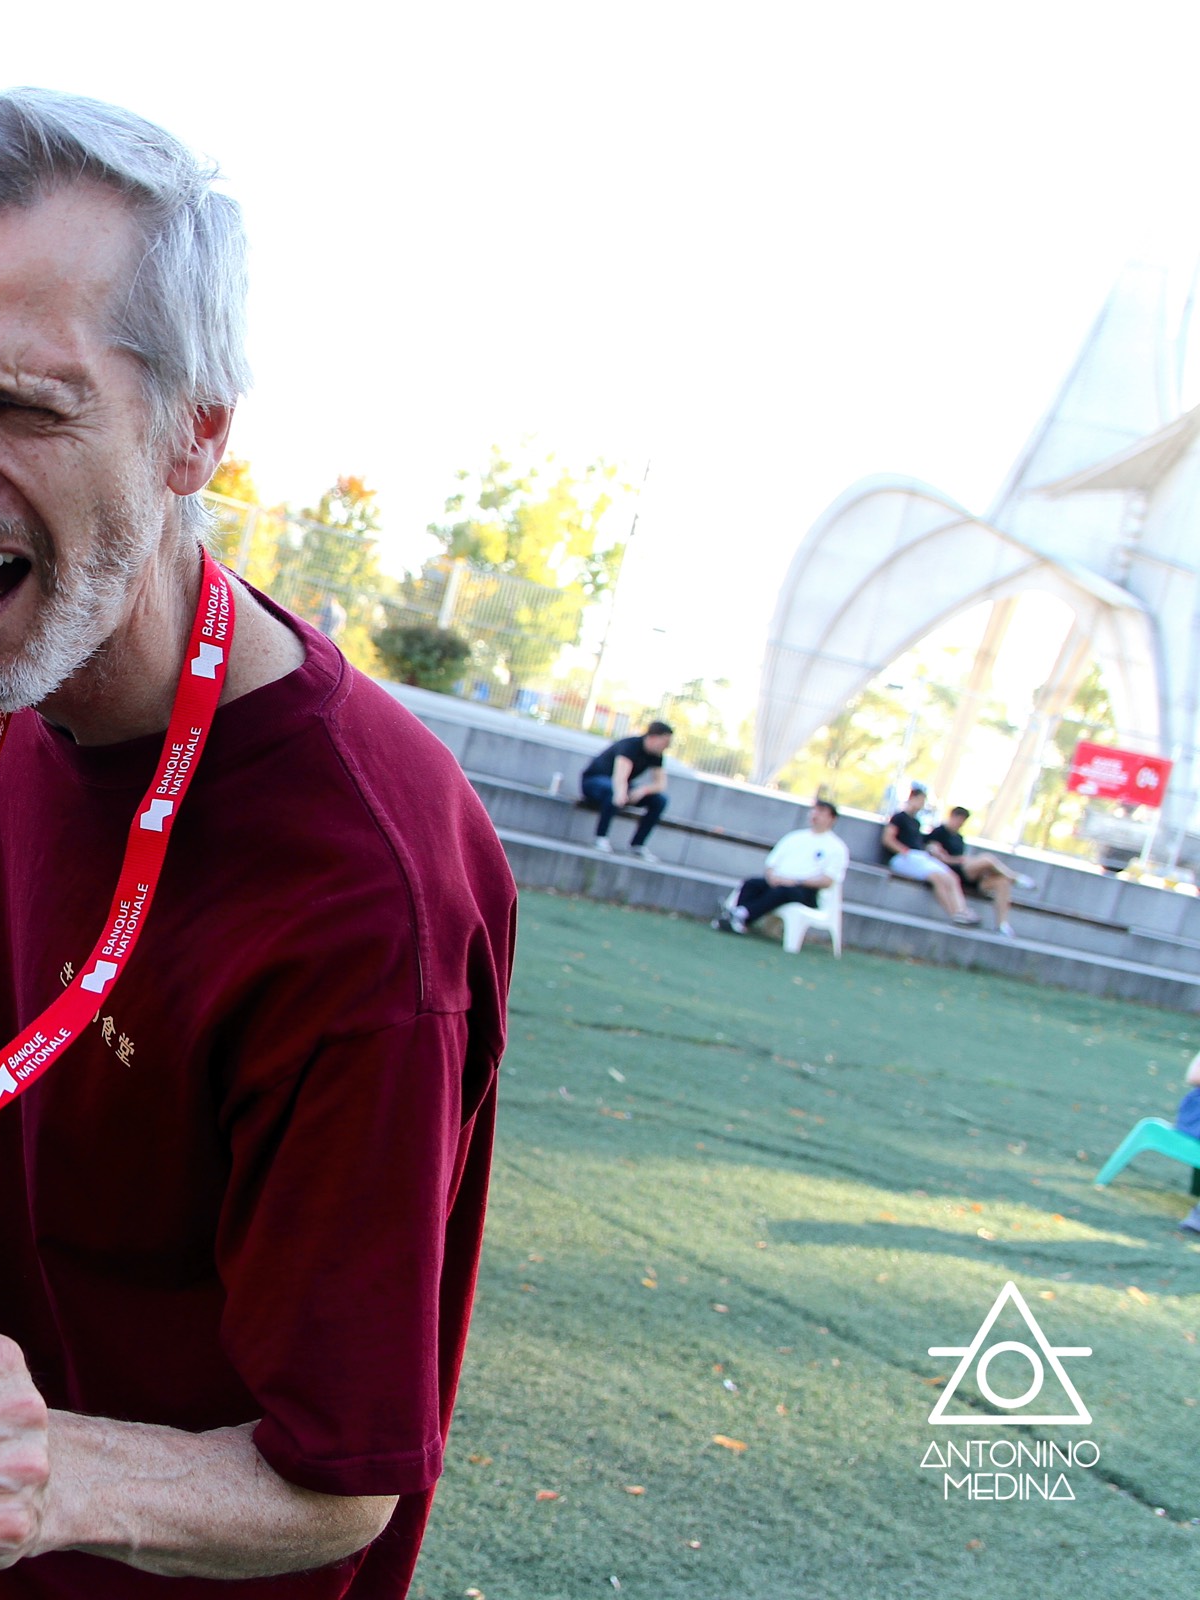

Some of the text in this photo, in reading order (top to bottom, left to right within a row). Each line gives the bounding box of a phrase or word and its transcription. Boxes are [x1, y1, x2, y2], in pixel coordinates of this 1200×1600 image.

[202, 583, 220, 637] BANQUE
[215, 579, 228, 641] NATIONALE
[156, 743, 184, 794] BANQUE
[168, 727, 201, 796] NATIONALE
[102, 900, 130, 956] BANQUE
[113, 883, 149, 958] NATIONALE
[7, 1031, 48, 1070] BANQUE
[15, 1027, 72, 1081] NATIONALE
